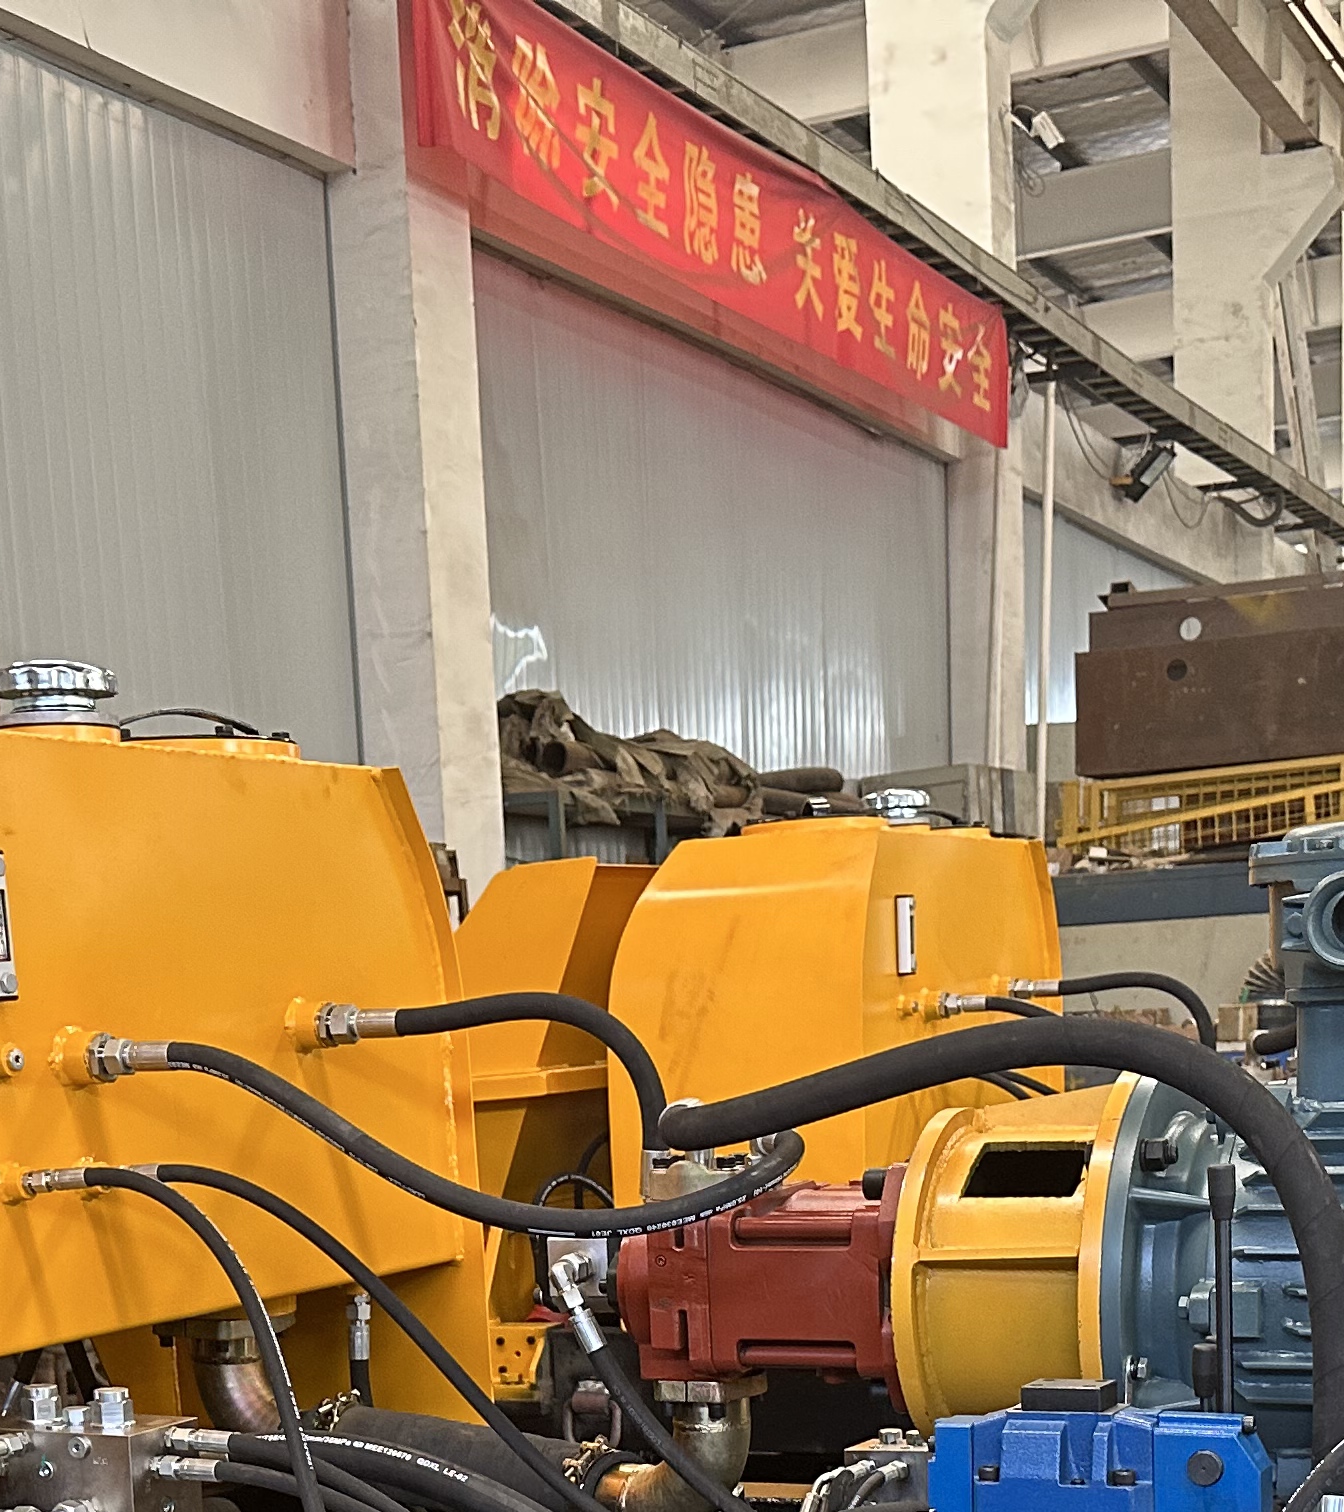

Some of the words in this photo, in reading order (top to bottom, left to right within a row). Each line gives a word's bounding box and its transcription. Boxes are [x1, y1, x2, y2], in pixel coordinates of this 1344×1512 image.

[448, 0, 767, 285] 消除安全隐患
[792, 206, 992, 412] 关爱生命安全
